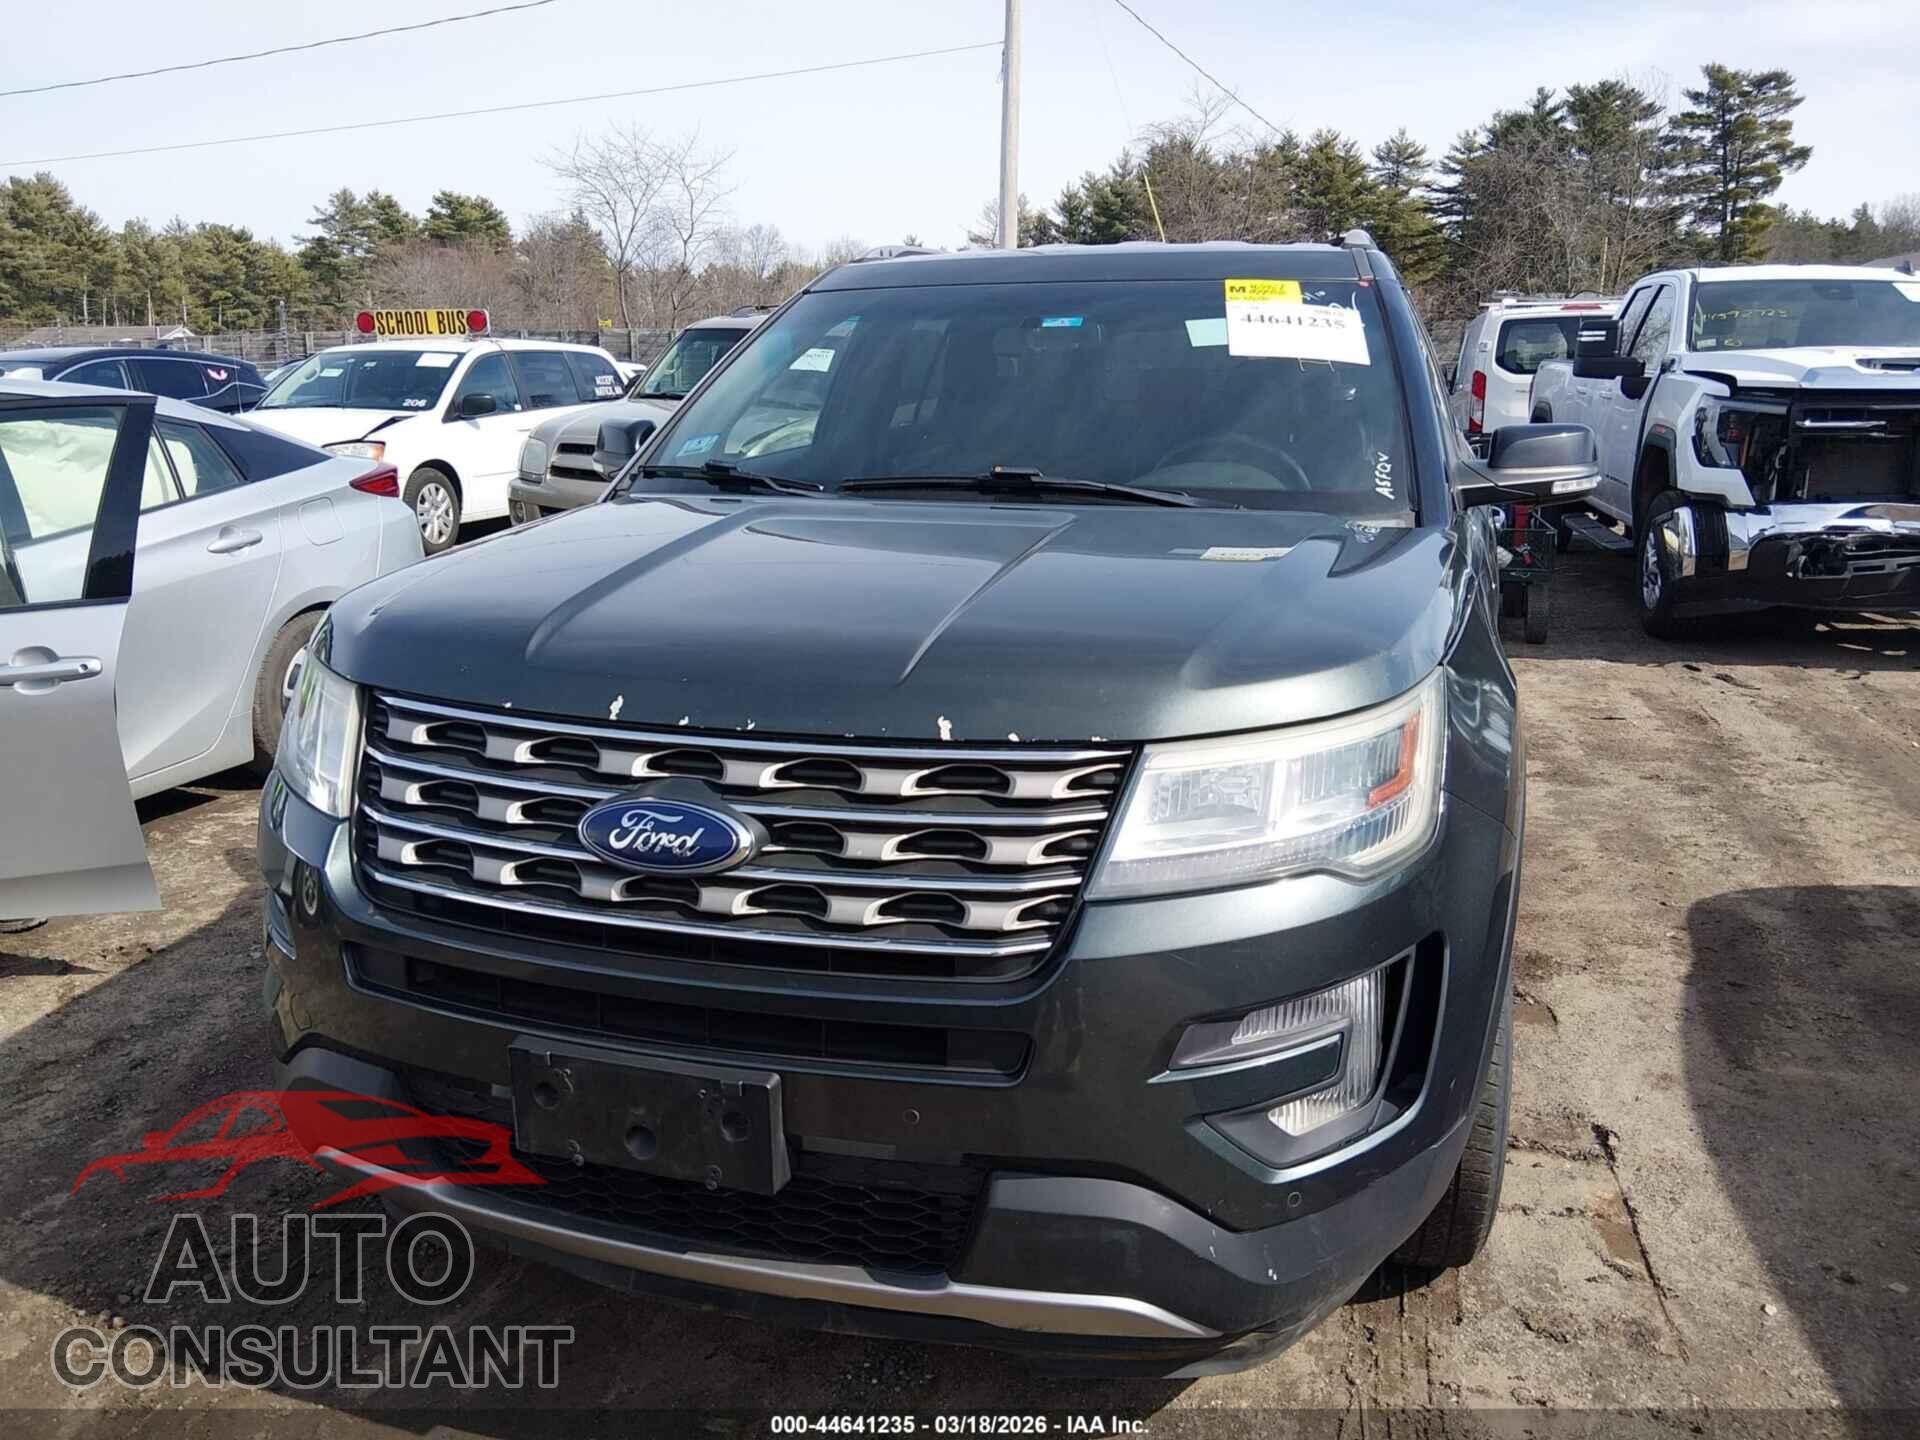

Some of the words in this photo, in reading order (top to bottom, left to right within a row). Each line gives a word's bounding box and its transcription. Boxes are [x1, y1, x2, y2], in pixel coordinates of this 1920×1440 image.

[376, 310, 432, 335] SCHOOL
[437, 310, 466, 335] BUS
[1240, 314, 1345, 329] 44641235
[609, 809, 705, 857] Ford
